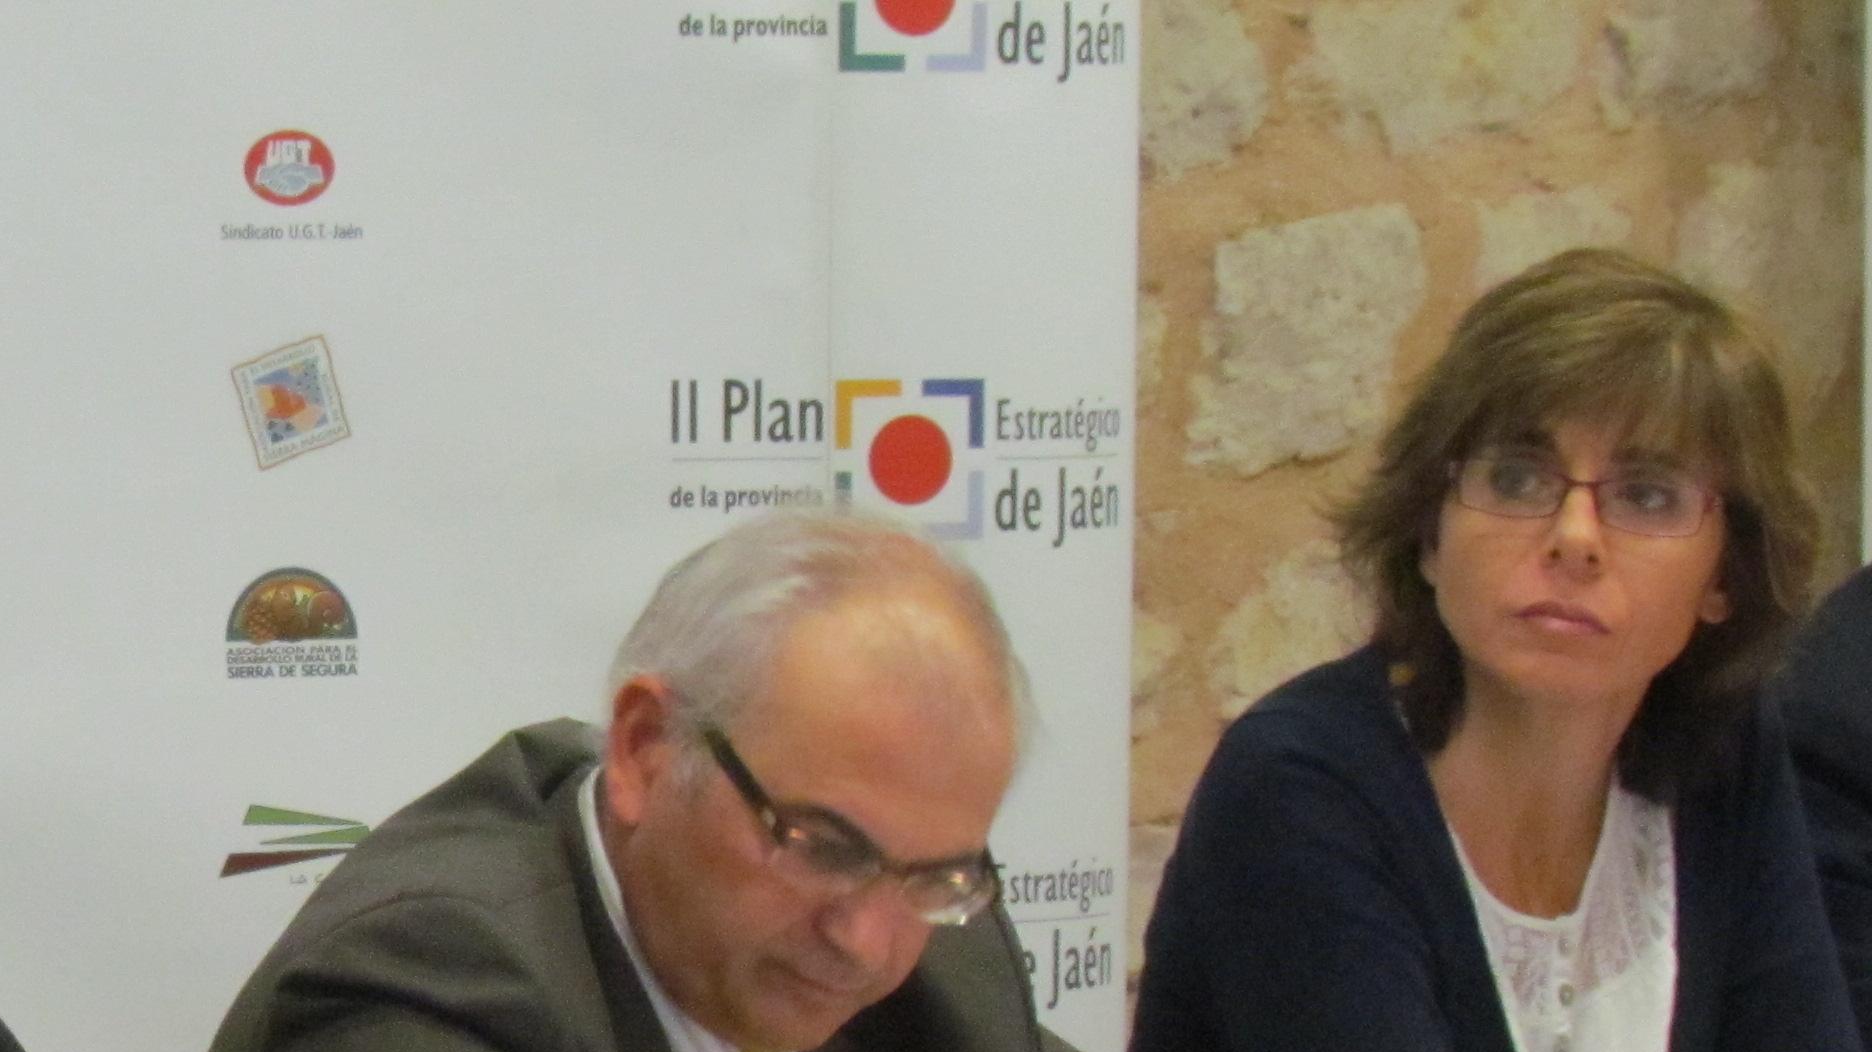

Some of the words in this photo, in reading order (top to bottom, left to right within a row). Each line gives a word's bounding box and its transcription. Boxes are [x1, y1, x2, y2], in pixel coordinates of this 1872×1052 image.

[678, 13, 702, 38] de
[710, 13, 728, 38] la
[733, 13, 828, 43] provincia
[996, 0, 1046, 65] de
[1057, 0, 1125, 83] Jaén
[220, 224, 284, 240] Sindicato
[670, 379, 698, 444] II
[723, 379, 825, 443] Plan
[996, 396, 1121, 452] Estratégico
[670, 486, 695, 508] de
[701, 485, 719, 508] la
[995, 468, 1042, 531] de
[1052, 466, 1120, 548] Jaén
[227, 665, 274, 679] SIERRA
[279, 664, 297, 678] DE
[301, 662, 358, 676] SEGURA
[1002, 858, 1114, 912] stratégico
[1047, 927, 1113, 1010] Jaén
